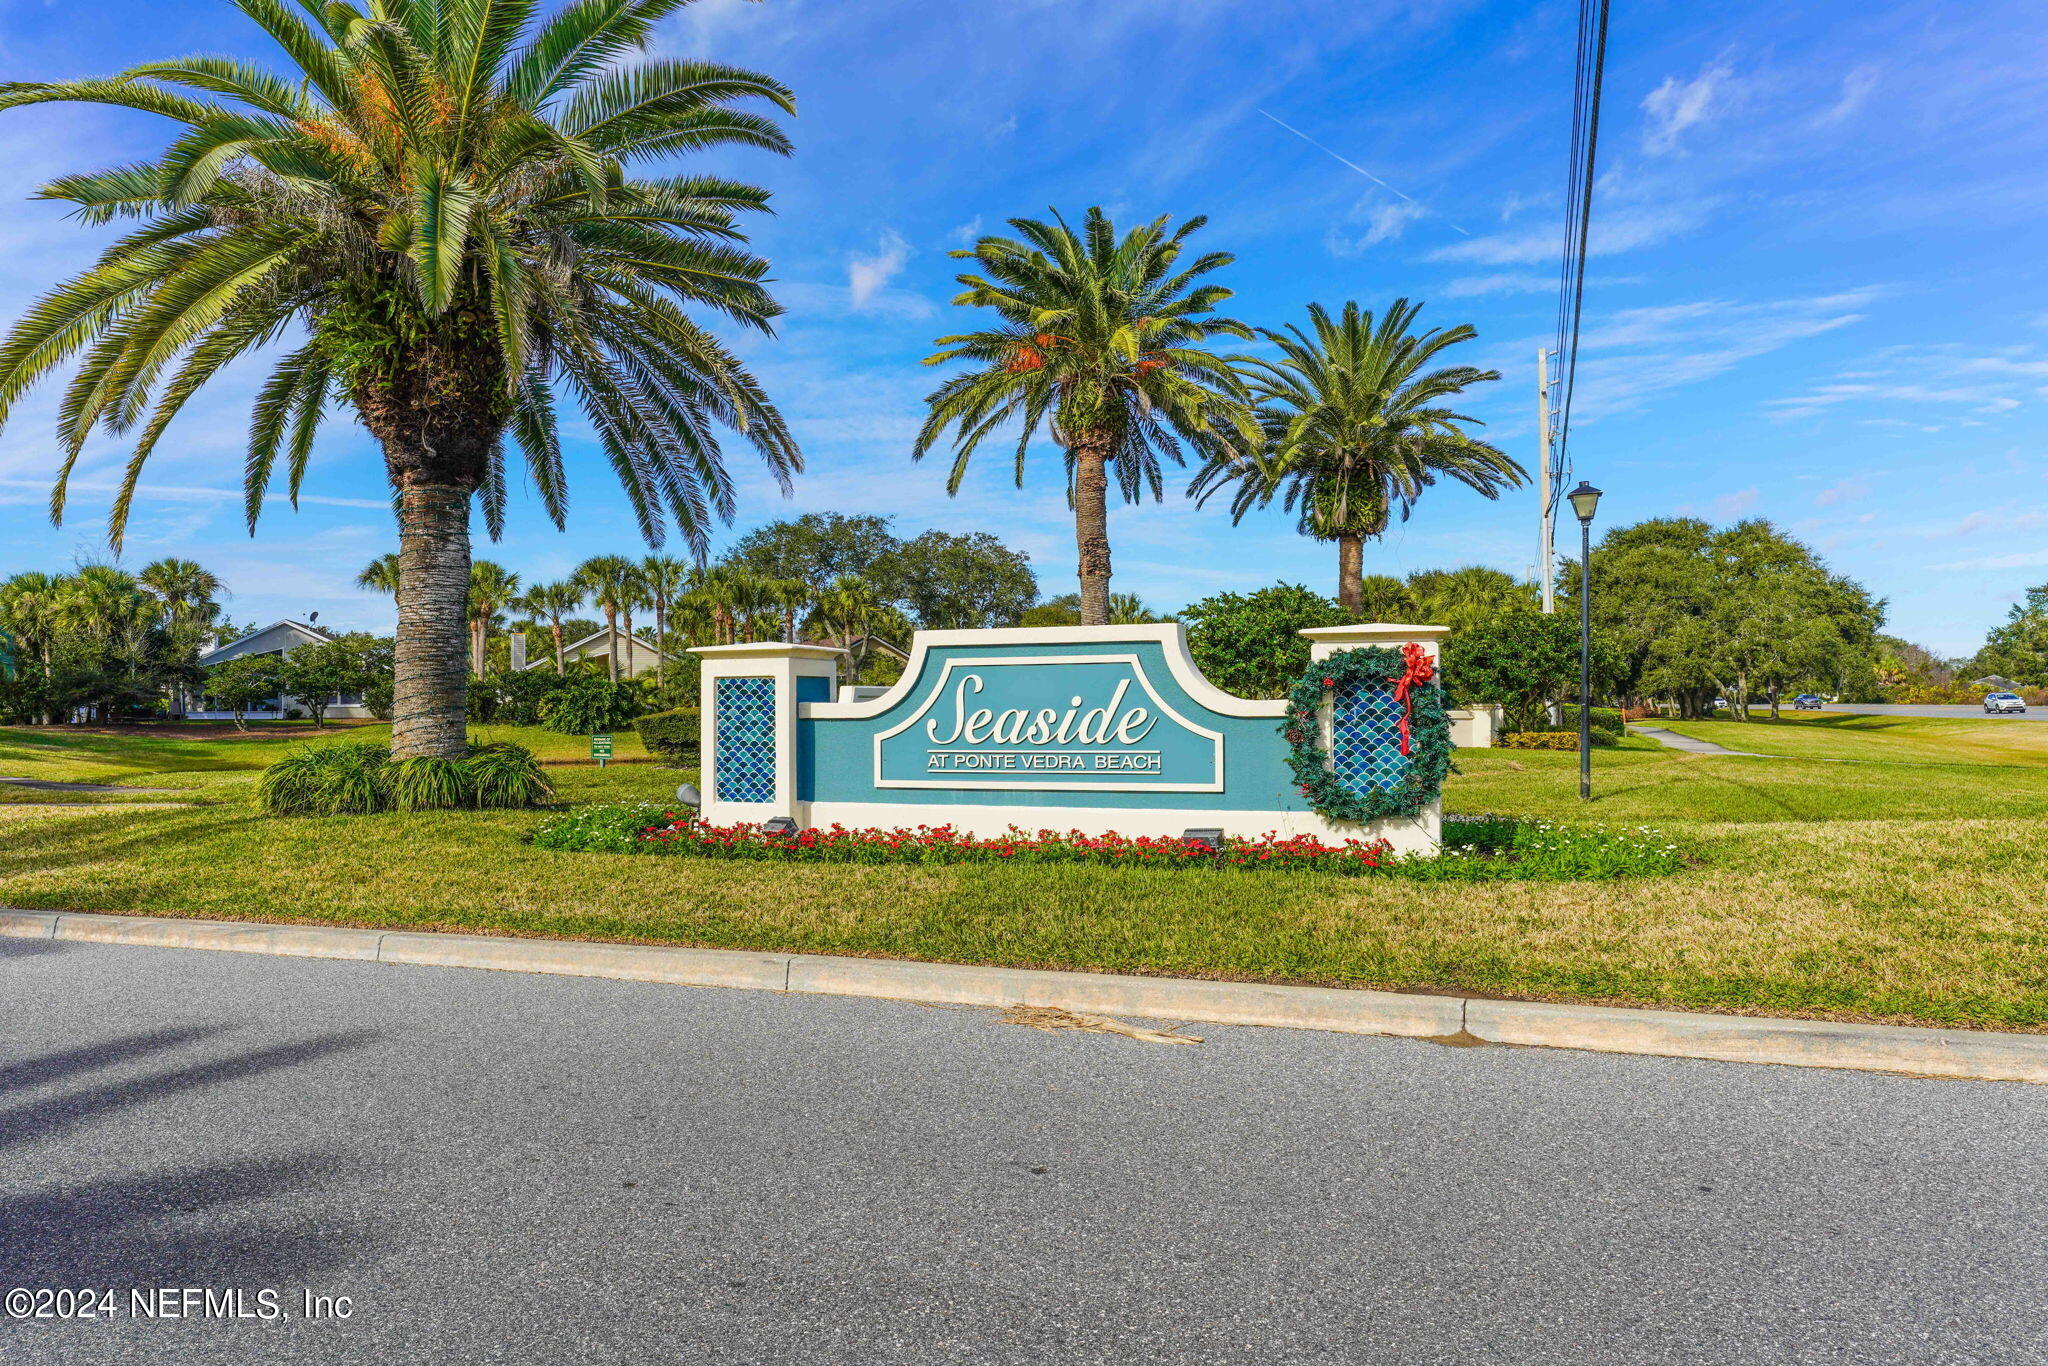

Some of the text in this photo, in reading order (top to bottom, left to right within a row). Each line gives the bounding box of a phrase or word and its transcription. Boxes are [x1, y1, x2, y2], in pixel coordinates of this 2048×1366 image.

[928, 675, 1158, 745] Seaside
[928, 755, 1162, 770] AT PONTE VEDRA BEACH
